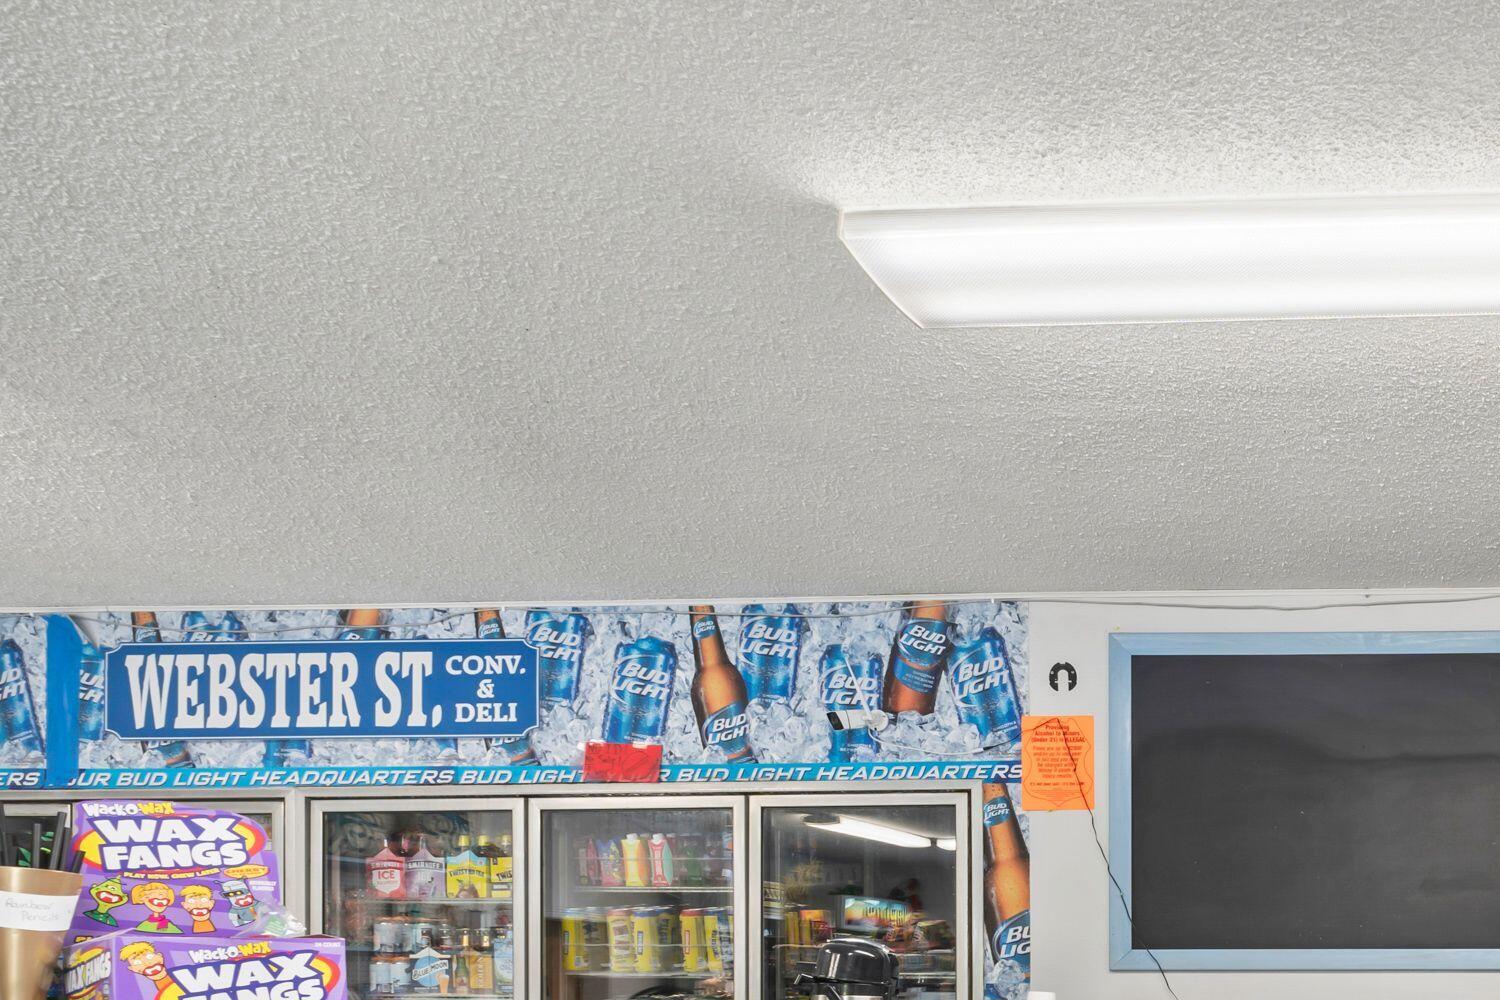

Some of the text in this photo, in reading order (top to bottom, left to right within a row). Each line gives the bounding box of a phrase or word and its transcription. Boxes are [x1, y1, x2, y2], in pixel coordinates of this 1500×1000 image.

[533, 626, 579, 646] BUD
[749, 623, 797, 642] BUD
[909, 624, 946, 644] BUD
[540, 644, 582, 661] GHT
[740, 638, 798, 658] LIGHT
[899, 633, 946, 656] LIGHT
[445, 655, 526, 675] CONV.
[622, 663, 669, 685] BUD
[958, 656, 1003, 680] BUD
[125, 652, 361, 729] WEBSTER
[476, 678, 495, 698] &
[613, 677, 670, 700] LIGHT
[956, 669, 1009, 698] LIGHT
[455, 703, 518, 722] DELI
[712, 713, 748, 731] BUD
[708, 724, 750, 745] LIGHT
[116, 771, 163, 787] BUD
[165, 770, 249, 787] LIGHT
[250, 769, 454, 786] HEADQUARTERS
[459, 769, 513, 785] BUD
[676, 768, 730, 783] BUD
[735, 767, 814, 782] LIGHT
[816, 764, 1023, 781] HEADQUARTERS
[984, 809, 1011, 821] LIGHT
[987, 802, 1008, 812] BUD
[94, 817, 237, 844] WAX
[103, 842, 248, 871] FANGS
[377, 870, 395, 879] ICE
[496, 870, 512, 881] TWIS
[172, 950, 318, 994] WAX
